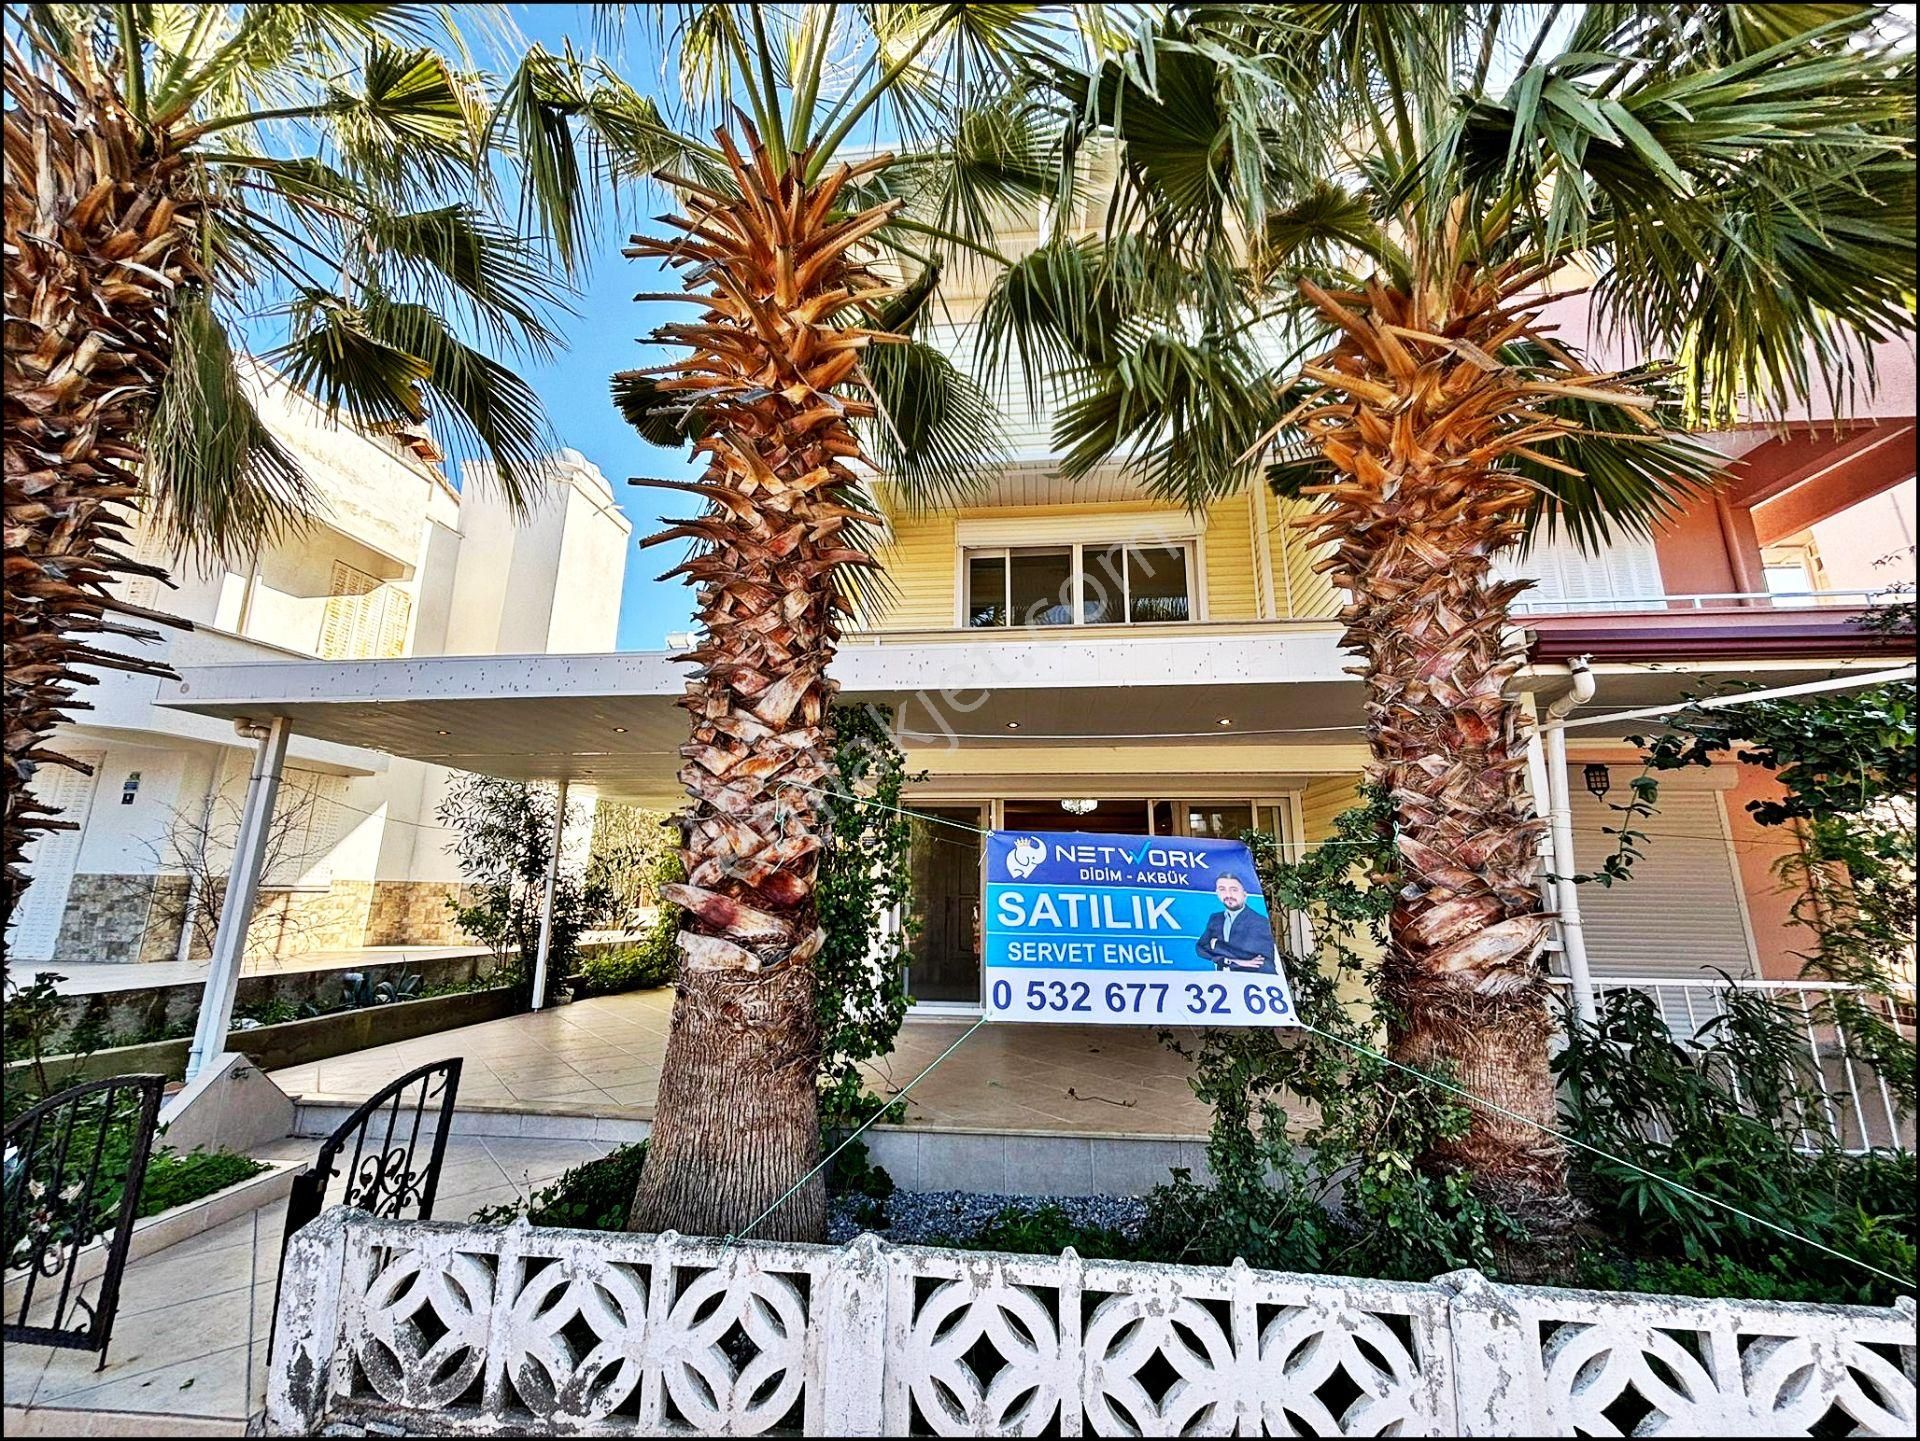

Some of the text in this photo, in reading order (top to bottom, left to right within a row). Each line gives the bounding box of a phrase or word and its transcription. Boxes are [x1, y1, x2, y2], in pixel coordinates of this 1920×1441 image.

[1055, 840, 1210, 869] NETWORK
[1079, 867, 1122, 882] DİDİM
[1136, 869, 1190, 886] AKBÜK
[997, 891, 1182, 930] SATILIK
[1007, 940, 1174, 964] SERVET ENGİL
[992, 979, 1290, 1016] 0 532 677 32 68
